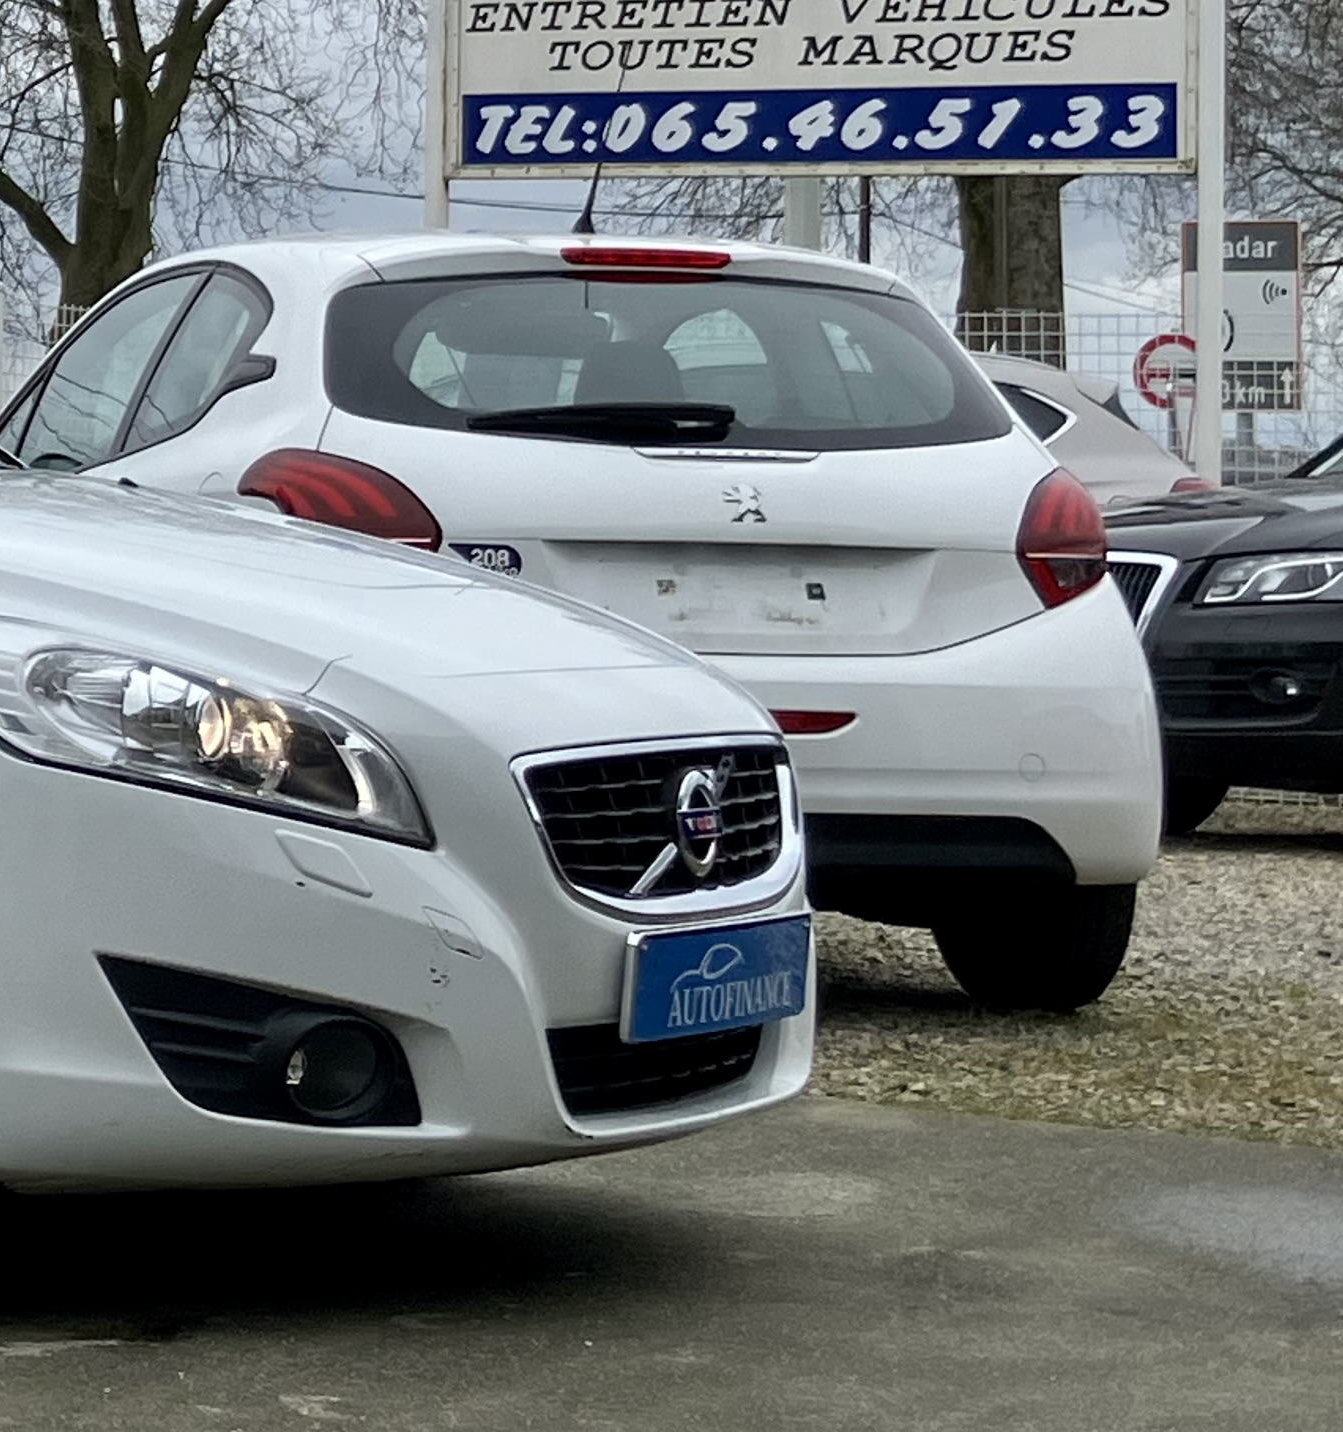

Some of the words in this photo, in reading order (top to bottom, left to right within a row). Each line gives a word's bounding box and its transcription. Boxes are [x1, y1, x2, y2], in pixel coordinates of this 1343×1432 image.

[548, 37, 758, 71] TOUTES
[797, 29, 1076, 71] MARQUES
[1222, 235, 1278, 259] adar
[470, 547, 509, 567] 208
[666, 970, 793, 1028] AUTOFINANCE
